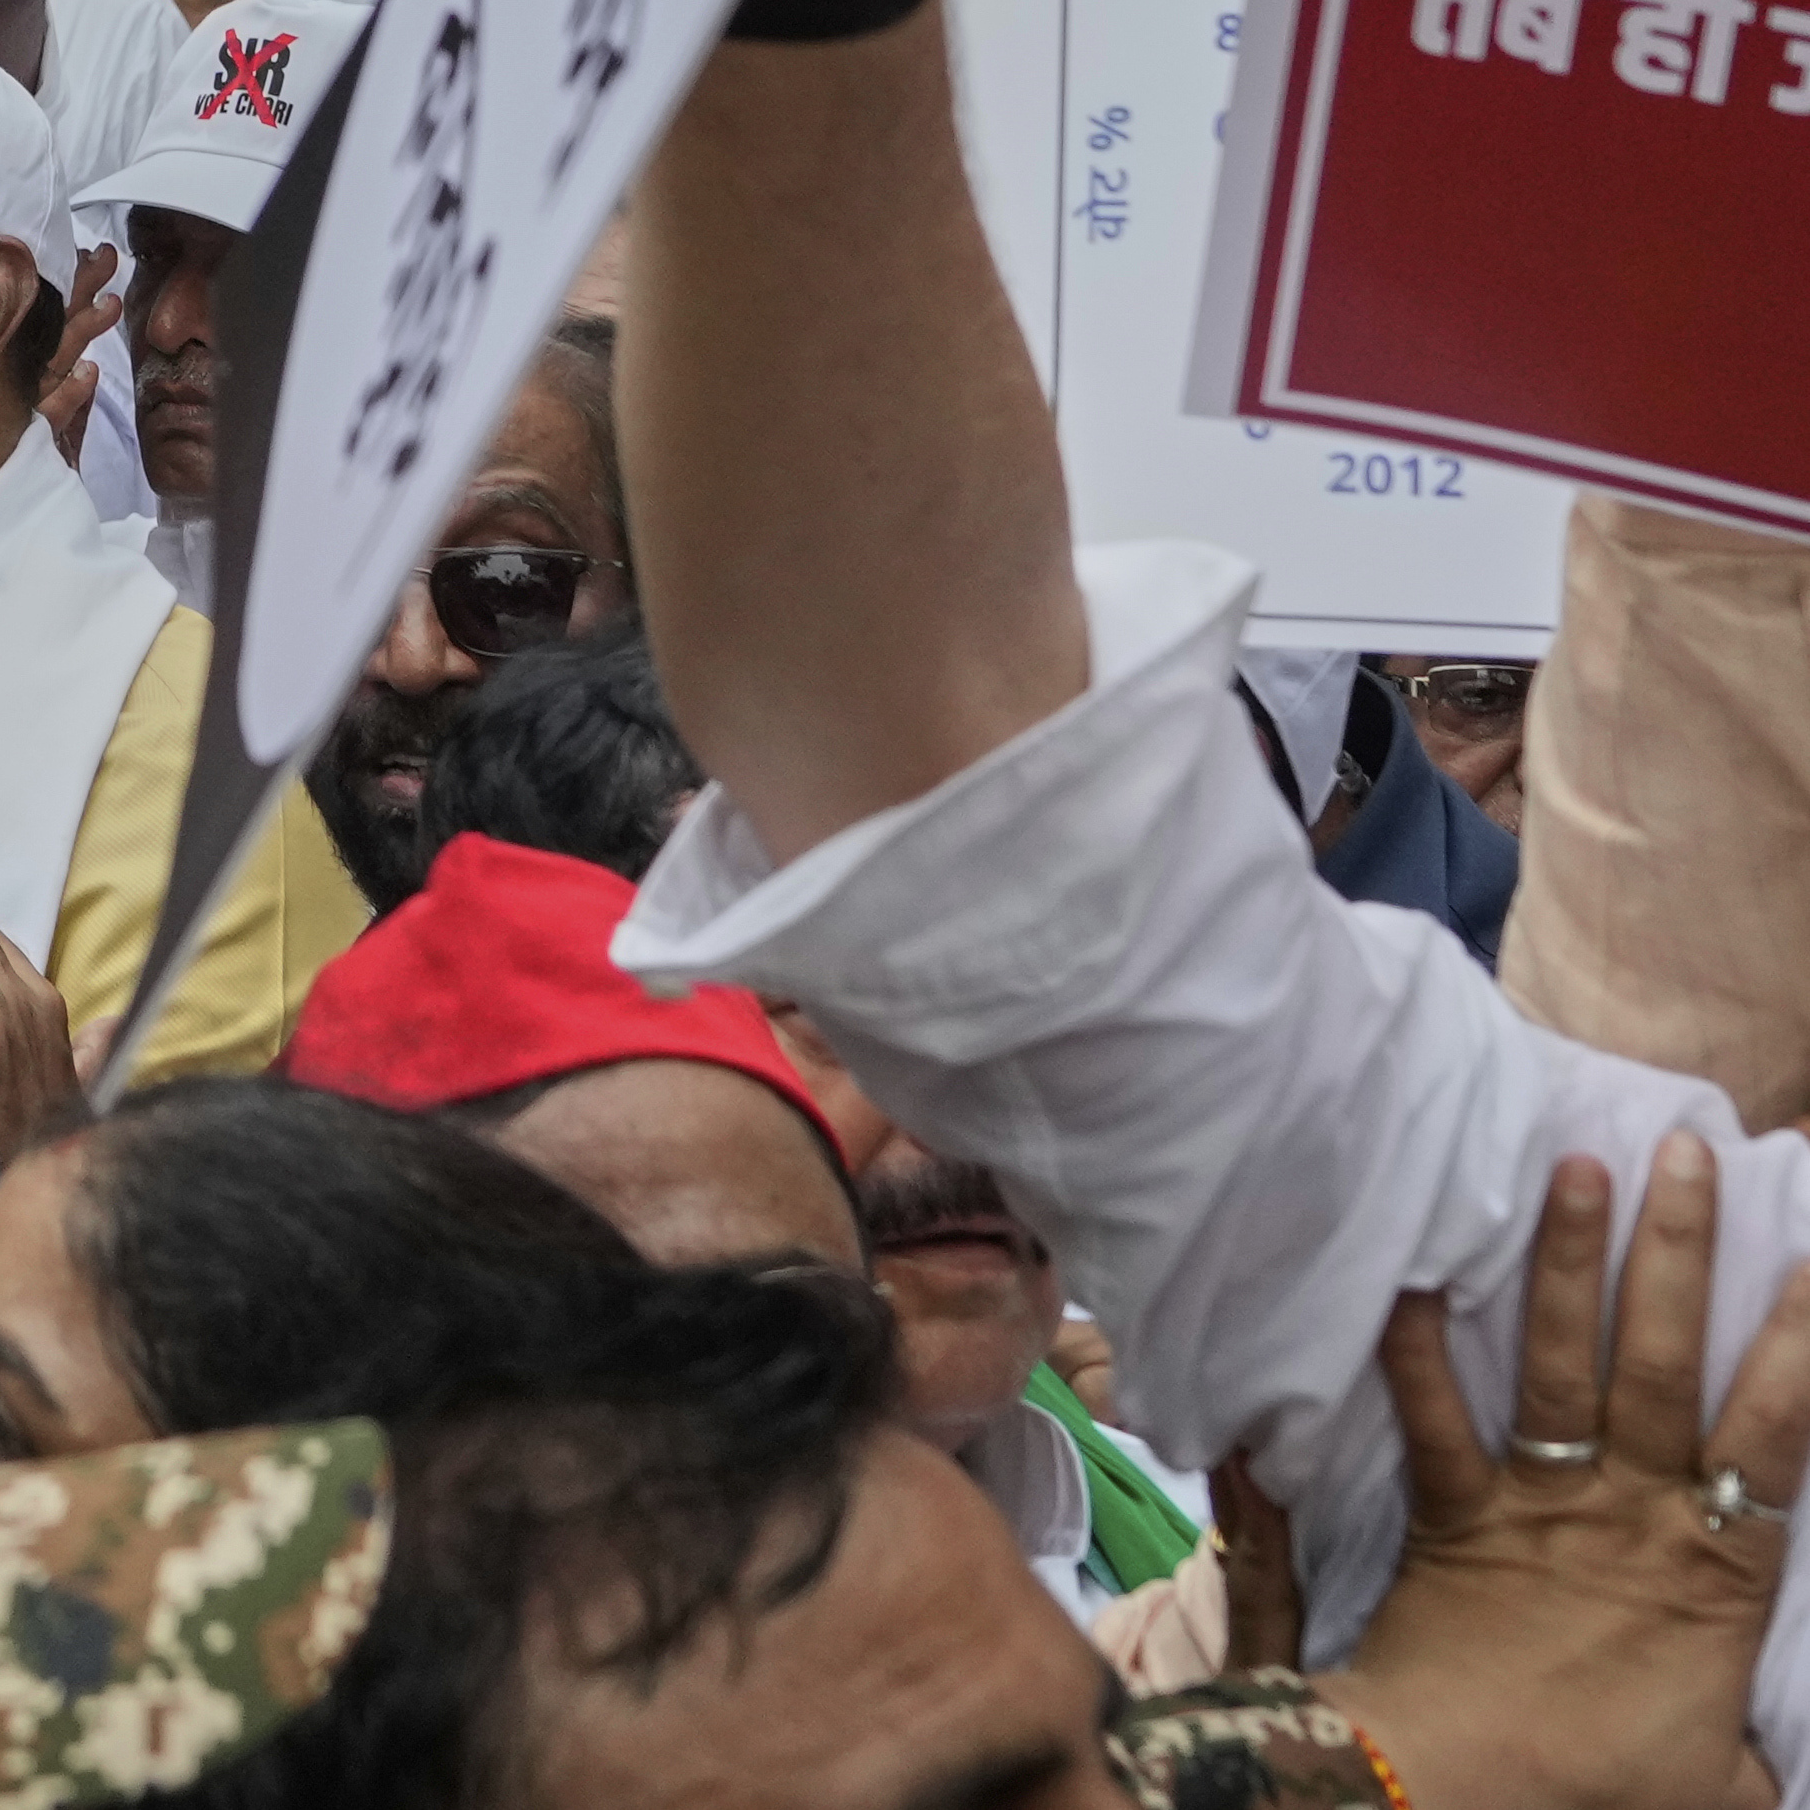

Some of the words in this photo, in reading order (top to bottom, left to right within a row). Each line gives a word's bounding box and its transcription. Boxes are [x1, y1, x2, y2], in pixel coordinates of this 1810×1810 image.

[214, 37, 291, 97] SIR
[194, 91, 230, 116] VOE
[1087, 105, 1131, 151] %
[1072, 164, 1129, 245] वोट
[1327, 452, 1465, 498] 2012
